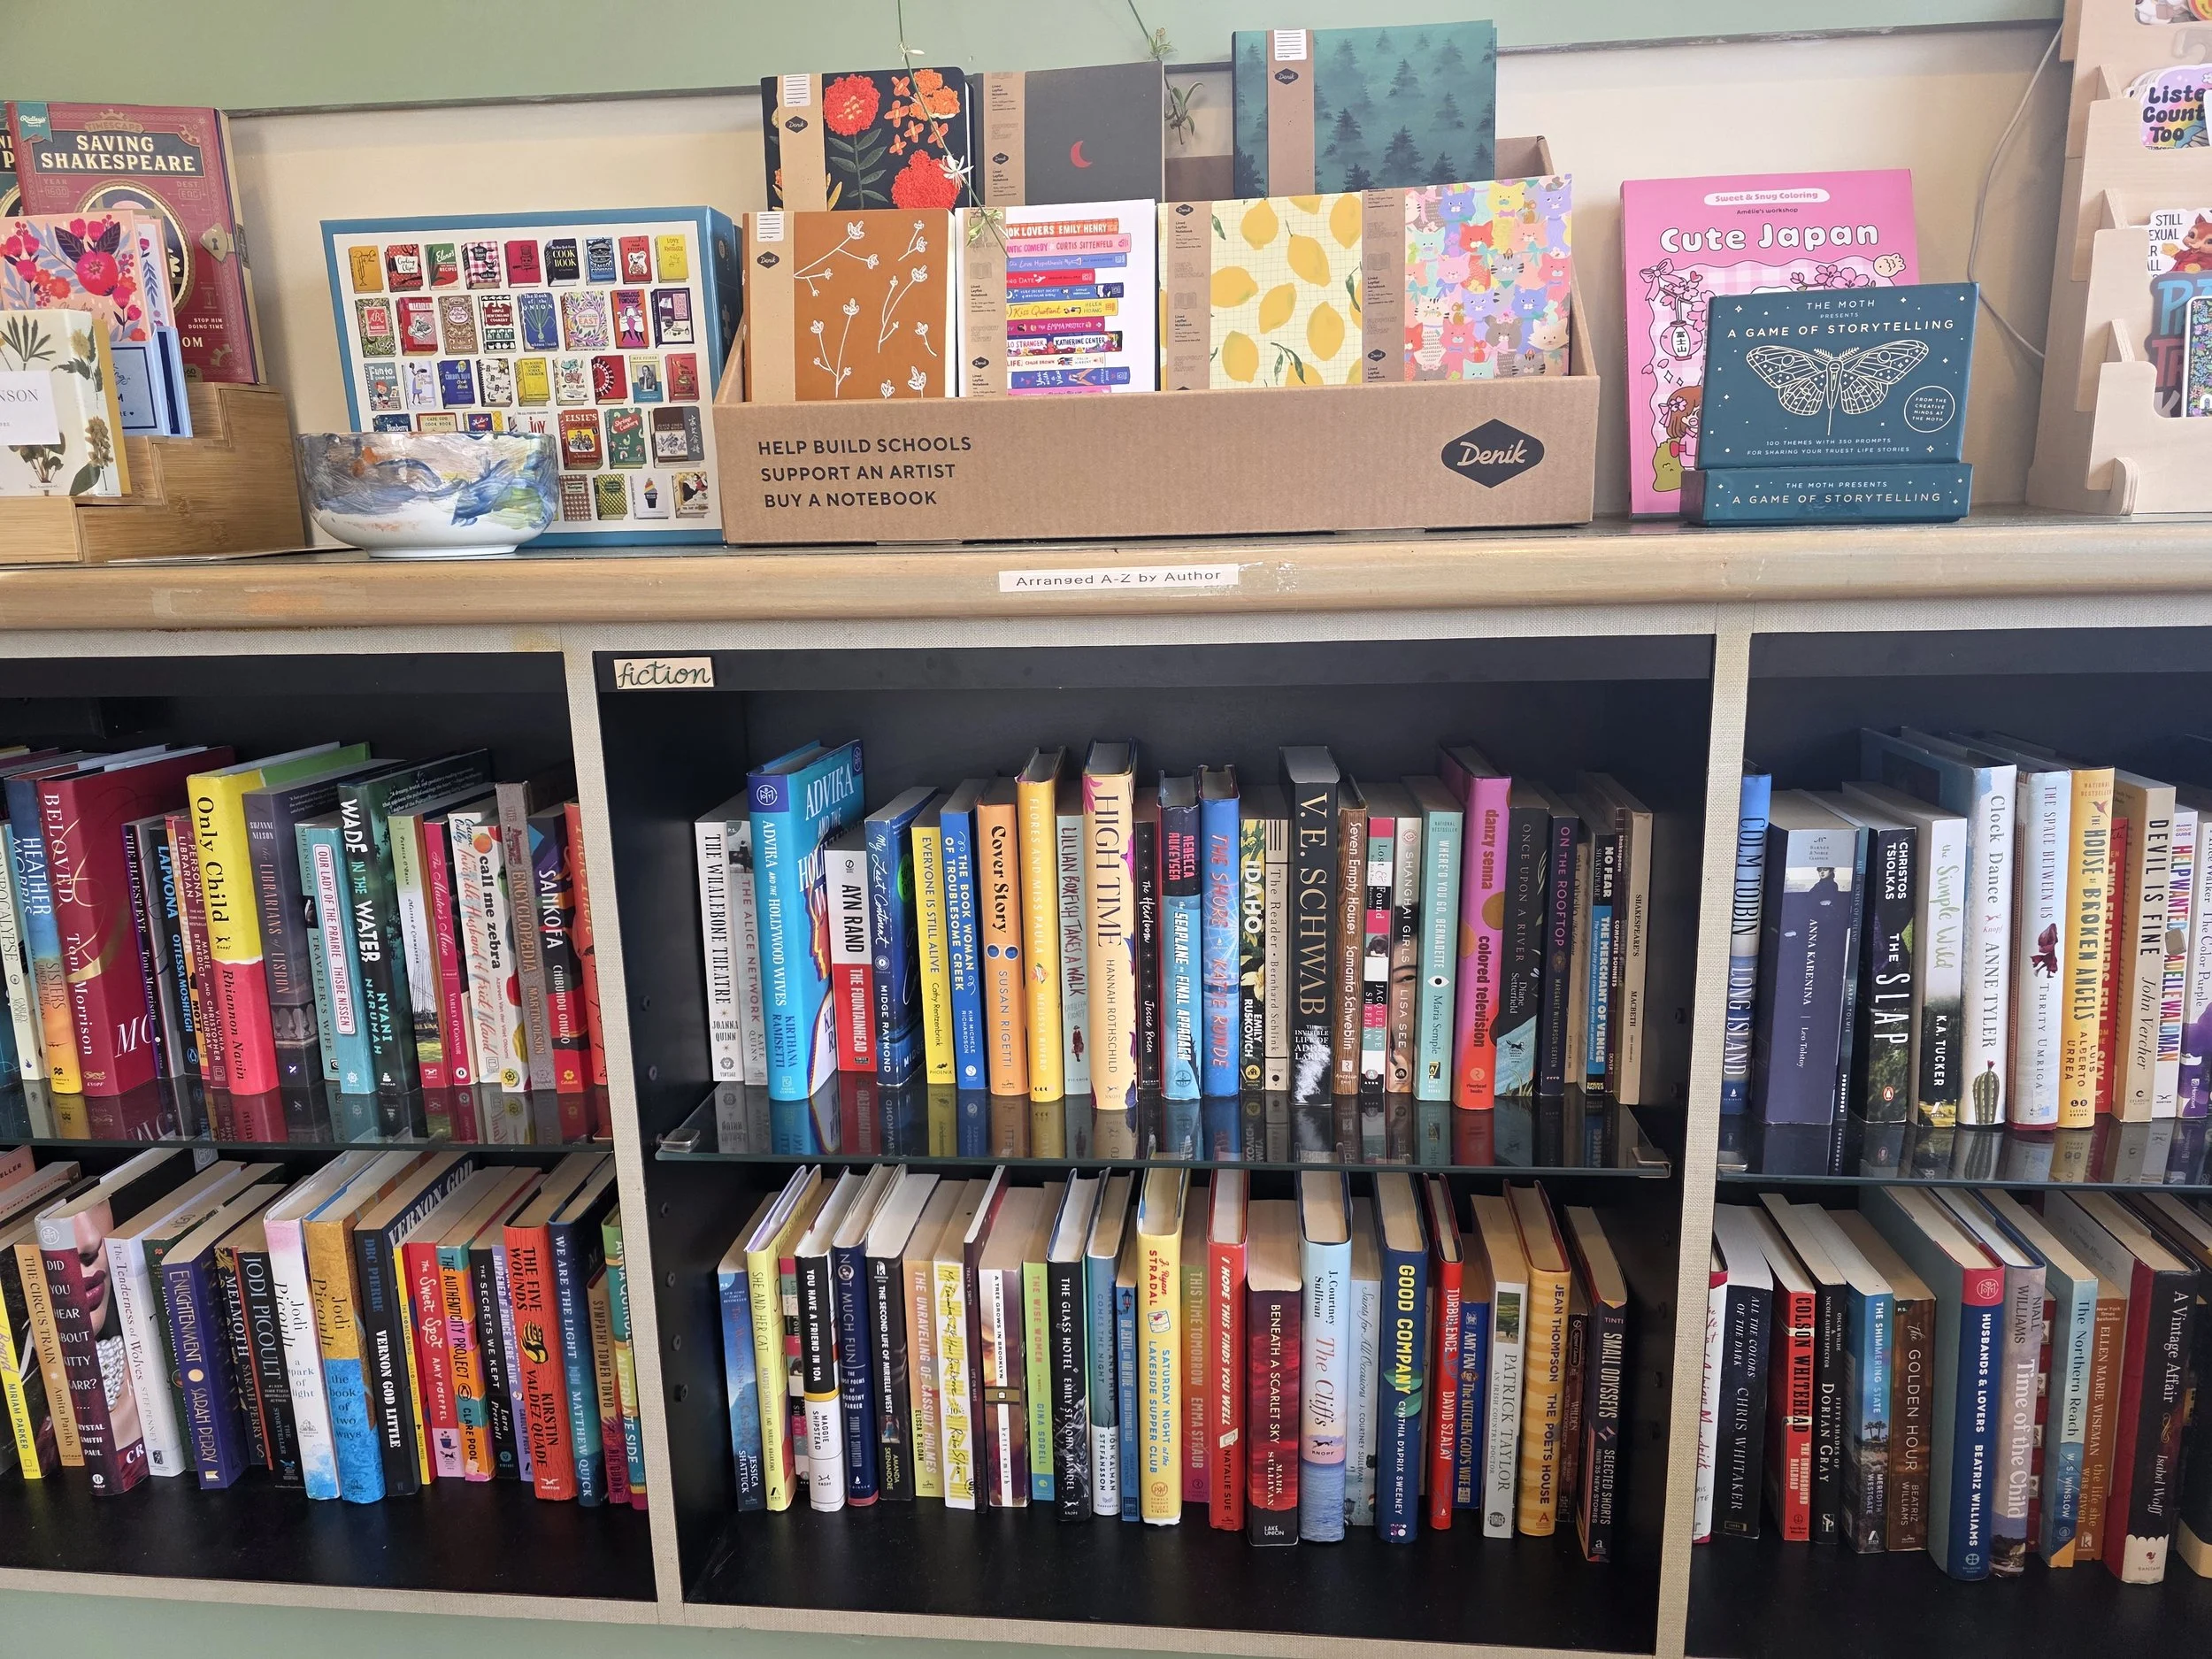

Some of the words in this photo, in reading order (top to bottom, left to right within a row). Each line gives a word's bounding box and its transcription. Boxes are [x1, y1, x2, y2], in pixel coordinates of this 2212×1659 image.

[77, 134, 154, 152] SAVING
[2150, 127, 2184, 143] Too
[41, 153, 196, 172] SHAKESPEARE
[1779, 191, 1818, 200] Coloring
[1022, 225, 1055, 237] LOVERS
[1059, 224, 1082, 234] EMILY
[1084, 223, 1107, 233] HENRY
[1660, 227, 1746, 253] Cute
[1758, 223, 1878, 251] Japan
[2156, 213, 2182, 225] STILL
[1056, 242, 1077, 250] CURTIS
[1079, 240, 1113, 250] SITTENFELD
[1807, 302, 1831, 311] THE
[1839, 300, 1875, 309] MOTH
[1056, 337, 1084, 346] KATHERINE
[1086, 336, 1105, 345] CENTER
[1727, 329, 1736, 338] A
[1746, 326, 1789, 337] GAME
[1799, 326, 1818, 335] OF
[1828, 320, 1954, 334] STORYTELLING
[758, 441, 807, 455] HELP
[814, 439, 871, 453] BUILD
[878, 437, 972, 453] SCHOOLS
[1457, 440, 1527, 466] Denik
[761, 466, 849, 481] SUPPORT
[856, 466, 883, 480] AN
[890, 465, 955, 479] ARTIST
[764, 494, 802, 508] BUY
[809, 494, 820, 506] A
[826, 491, 936, 506] NOTEBOOK
[1732, 495, 1740, 504] A
[1798, 495, 1816, 503] OF
[1824, 493, 1940, 503] STORYTELLING
[1017, 575, 1093, 587] Arranged
[1101, 574, 1131, 583] A-Z
[1139, 573, 1156, 582] by
[1164, 572, 1221, 581] Author
[618, 661, 710, 687] fiction
[197, 797, 214, 852] Only
[341, 799, 368, 853] WADE
[1300, 793, 1327, 818] V.
[1989, 795, 2004, 843] Clock
[44, 794, 73, 902] BELOVED
[705, 834, 721, 856] THE
[763, 820, 779, 871] ADVIKA
[1094, 795, 1119, 870] HIGH
[1300, 836, 1326, 856] E.
[1482, 810, 1498, 846] danzy
[1739, 818, 1765, 872] COLM
[2146, 819, 2169, 874] DEVIL
[352, 861, 365, 872] IN
[480, 856, 493, 881] call
[991, 826, 1006, 879] Cover
[1482, 850, 1494, 889] senna
[1604, 847, 1613, 864] NO
[1885, 842, 1896, 900] TSIOLKAS
[1898, 841, 1908, 899] CHRISTOS
[205, 862, 229, 923] Child
[354, 875, 366, 894] THE
[841, 885, 862, 910] AYN
[1603, 868, 1612, 898] FEAR
[1987, 853, 2003, 904] Dance
[2145, 886, 2163, 902] IS
[485, 890, 495, 916] me
[540, 870, 561, 949] SANKOFA
[707, 862, 728, 944] WHALEBONE
[994, 883, 1008, 933] Story
[1096, 877, 1122, 946] TIME
[355, 900, 380, 962] WATER
[487, 922, 501, 969] zebra
[771, 899, 785, 971] HOLLYWOOD
[844, 918, 864, 953] RAND
[1300, 868, 1326, 1015] SCHWAB
[1809, 918, 1817, 948] ANNA
[2140, 914, 2162, 956] FINE
[66, 933, 81, 974] Toni
[1476, 936, 1489, 984] colored
[712, 947, 731, 1004] THEATRE
[774, 973, 787, 1006] WIVES
[850, 968, 863, 985] THE
[1728, 966, 1755, 1014] LONG
[1803, 950, 1816, 1005] KARENINA
[73, 979, 93, 1056] Morrison
[850, 988, 868, 1053] FOUNTAINHEAD
[1474, 987, 1488, 1047] television
[1724, 1017, 1749, 1075] ISLAND
[243, 1257, 265, 1297] JODI
[1398, 1265, 1416, 1312] GOOD
[1062, 1298, 1071, 1332] GLASS
[1795, 1297, 1811, 1348] COLSON
[253, 1305, 280, 1379] PICOULT
[376, 1330, 392, 1379] VERNON
[1063, 1335, 1072, 1369] HOTEL
[1317, 1338, 1334, 1372] The
[1396, 1318, 1413, 1394] COMPANY
[1979, 1314, 1991, 1375] HUSBANDS
[1148, 1340, 1157, 1392] LAKESIDE
[190, 1387, 211, 1424] SARAH
[381, 1382, 396, 1403] GOD
[1310, 1379, 1335, 1427] Cliffs
[1501, 1353, 1517, 1423] PATRICK
[1793, 1354, 1810, 1433] WHITEHEAD
[386, 1408, 401, 1448] LITTLE
[1148, 1396, 1157, 1440] SUPPER
[1976, 1391, 1989, 1432] LOVERS
[197, 1426, 219, 1463] PERRY
[1497, 1429, 1514, 1492] TAYLOR
[1973, 1445, 1983, 1488] BEATRIZ
[1969, 1494, 1980, 1546] WILLIAMS
